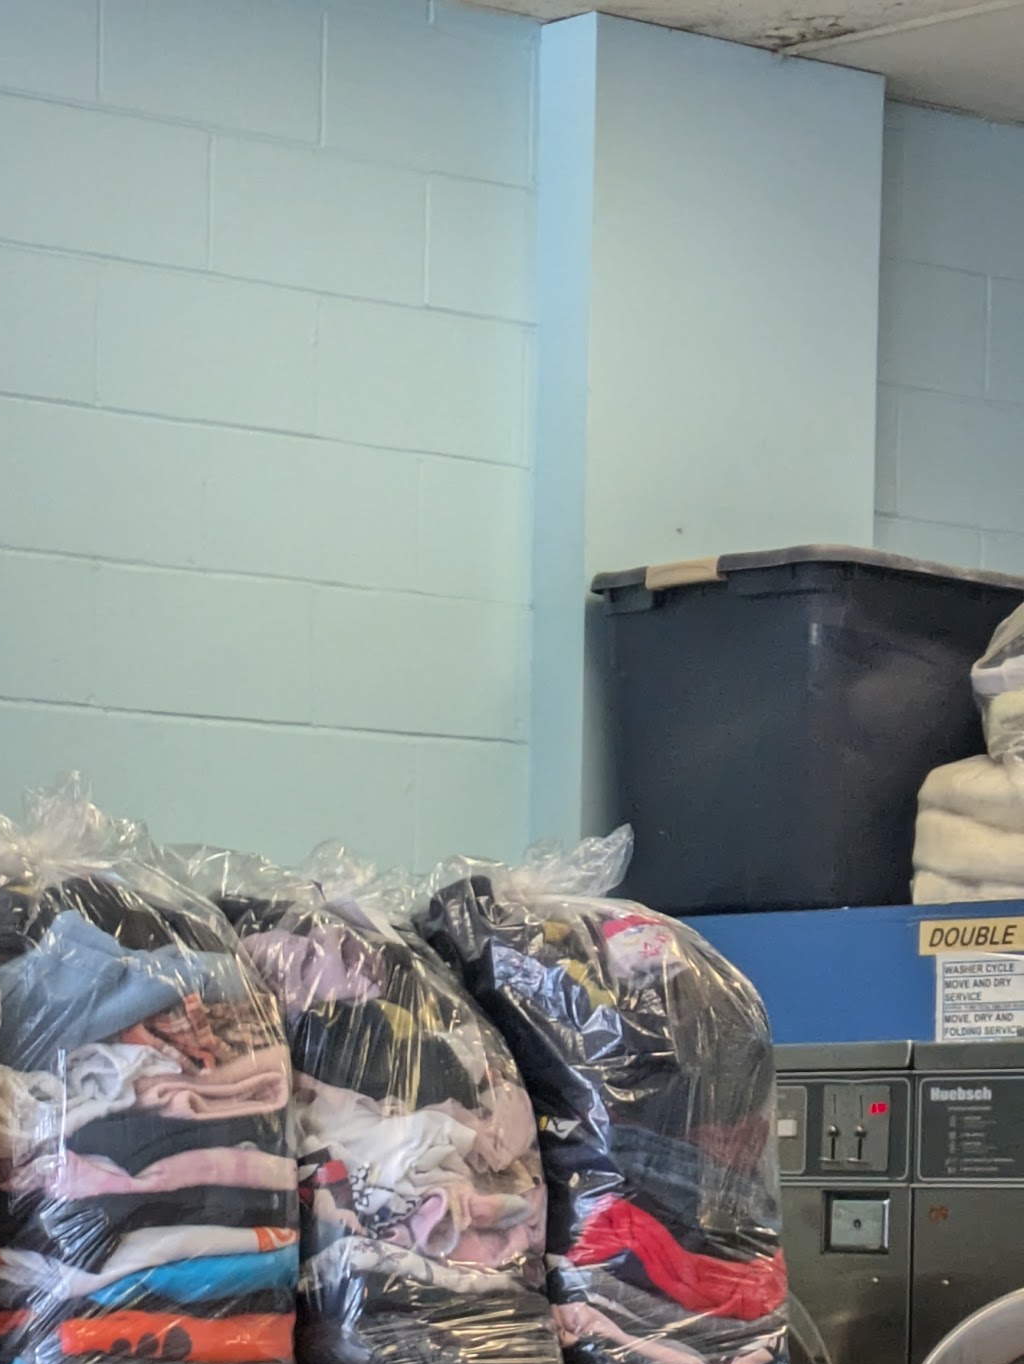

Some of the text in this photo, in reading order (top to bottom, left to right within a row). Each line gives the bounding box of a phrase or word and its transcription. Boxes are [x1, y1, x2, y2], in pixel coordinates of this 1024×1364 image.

[929, 924, 1017, 947] DOUBLE
[944, 963, 1014, 974] WASHER CYCLE
[944, 978, 1012, 989] MOVE AND DRY
[944, 992, 982, 1001] SERVICE
[974, 1013, 994, 1022] DRY
[996, 1012, 1014, 1022] AND
[944, 1027, 981, 1037] FOLDING
[930, 1086, 992, 1101] Huebsch
